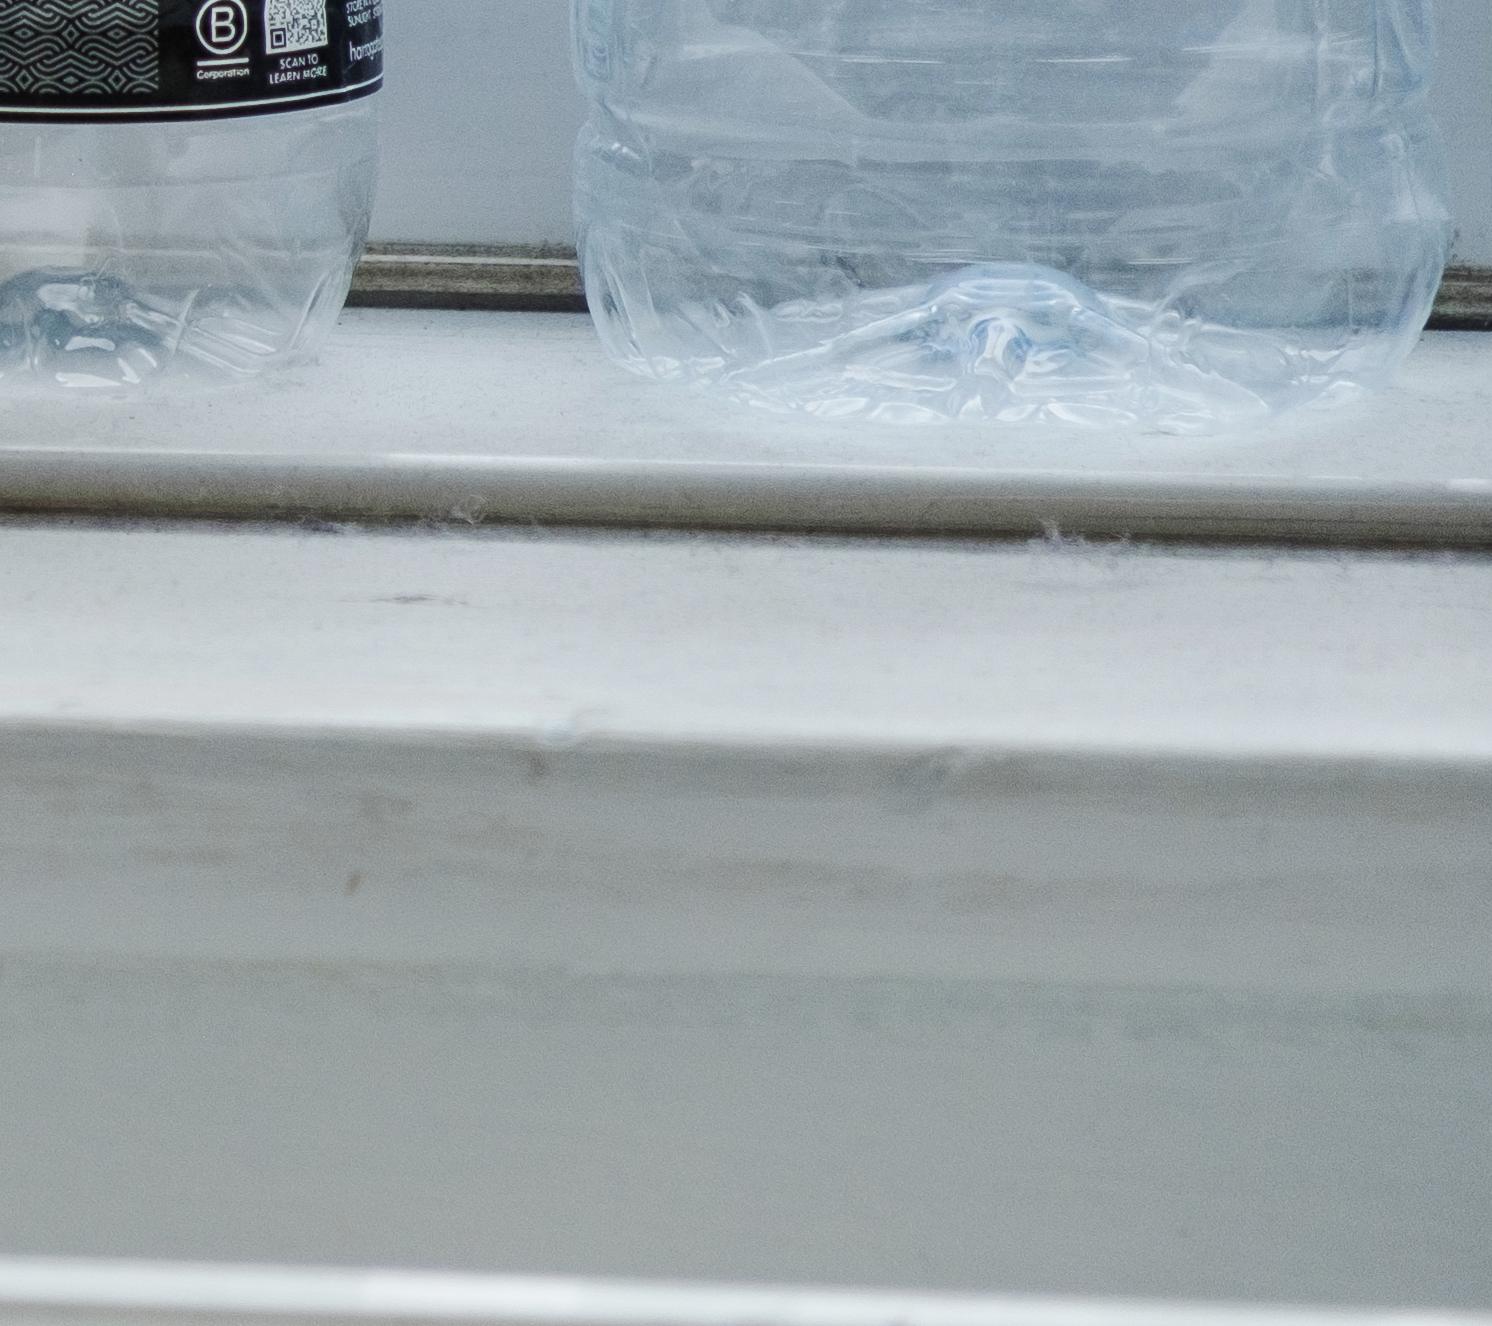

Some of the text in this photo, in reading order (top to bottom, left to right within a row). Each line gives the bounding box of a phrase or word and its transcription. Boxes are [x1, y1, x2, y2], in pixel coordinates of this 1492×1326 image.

[210, 6, 236, 43] B
[280, 52, 319, 71] SCAN TO
[196, 67, 250, 80] Corporation
[268, 65, 327, 85] LEARN MORE
